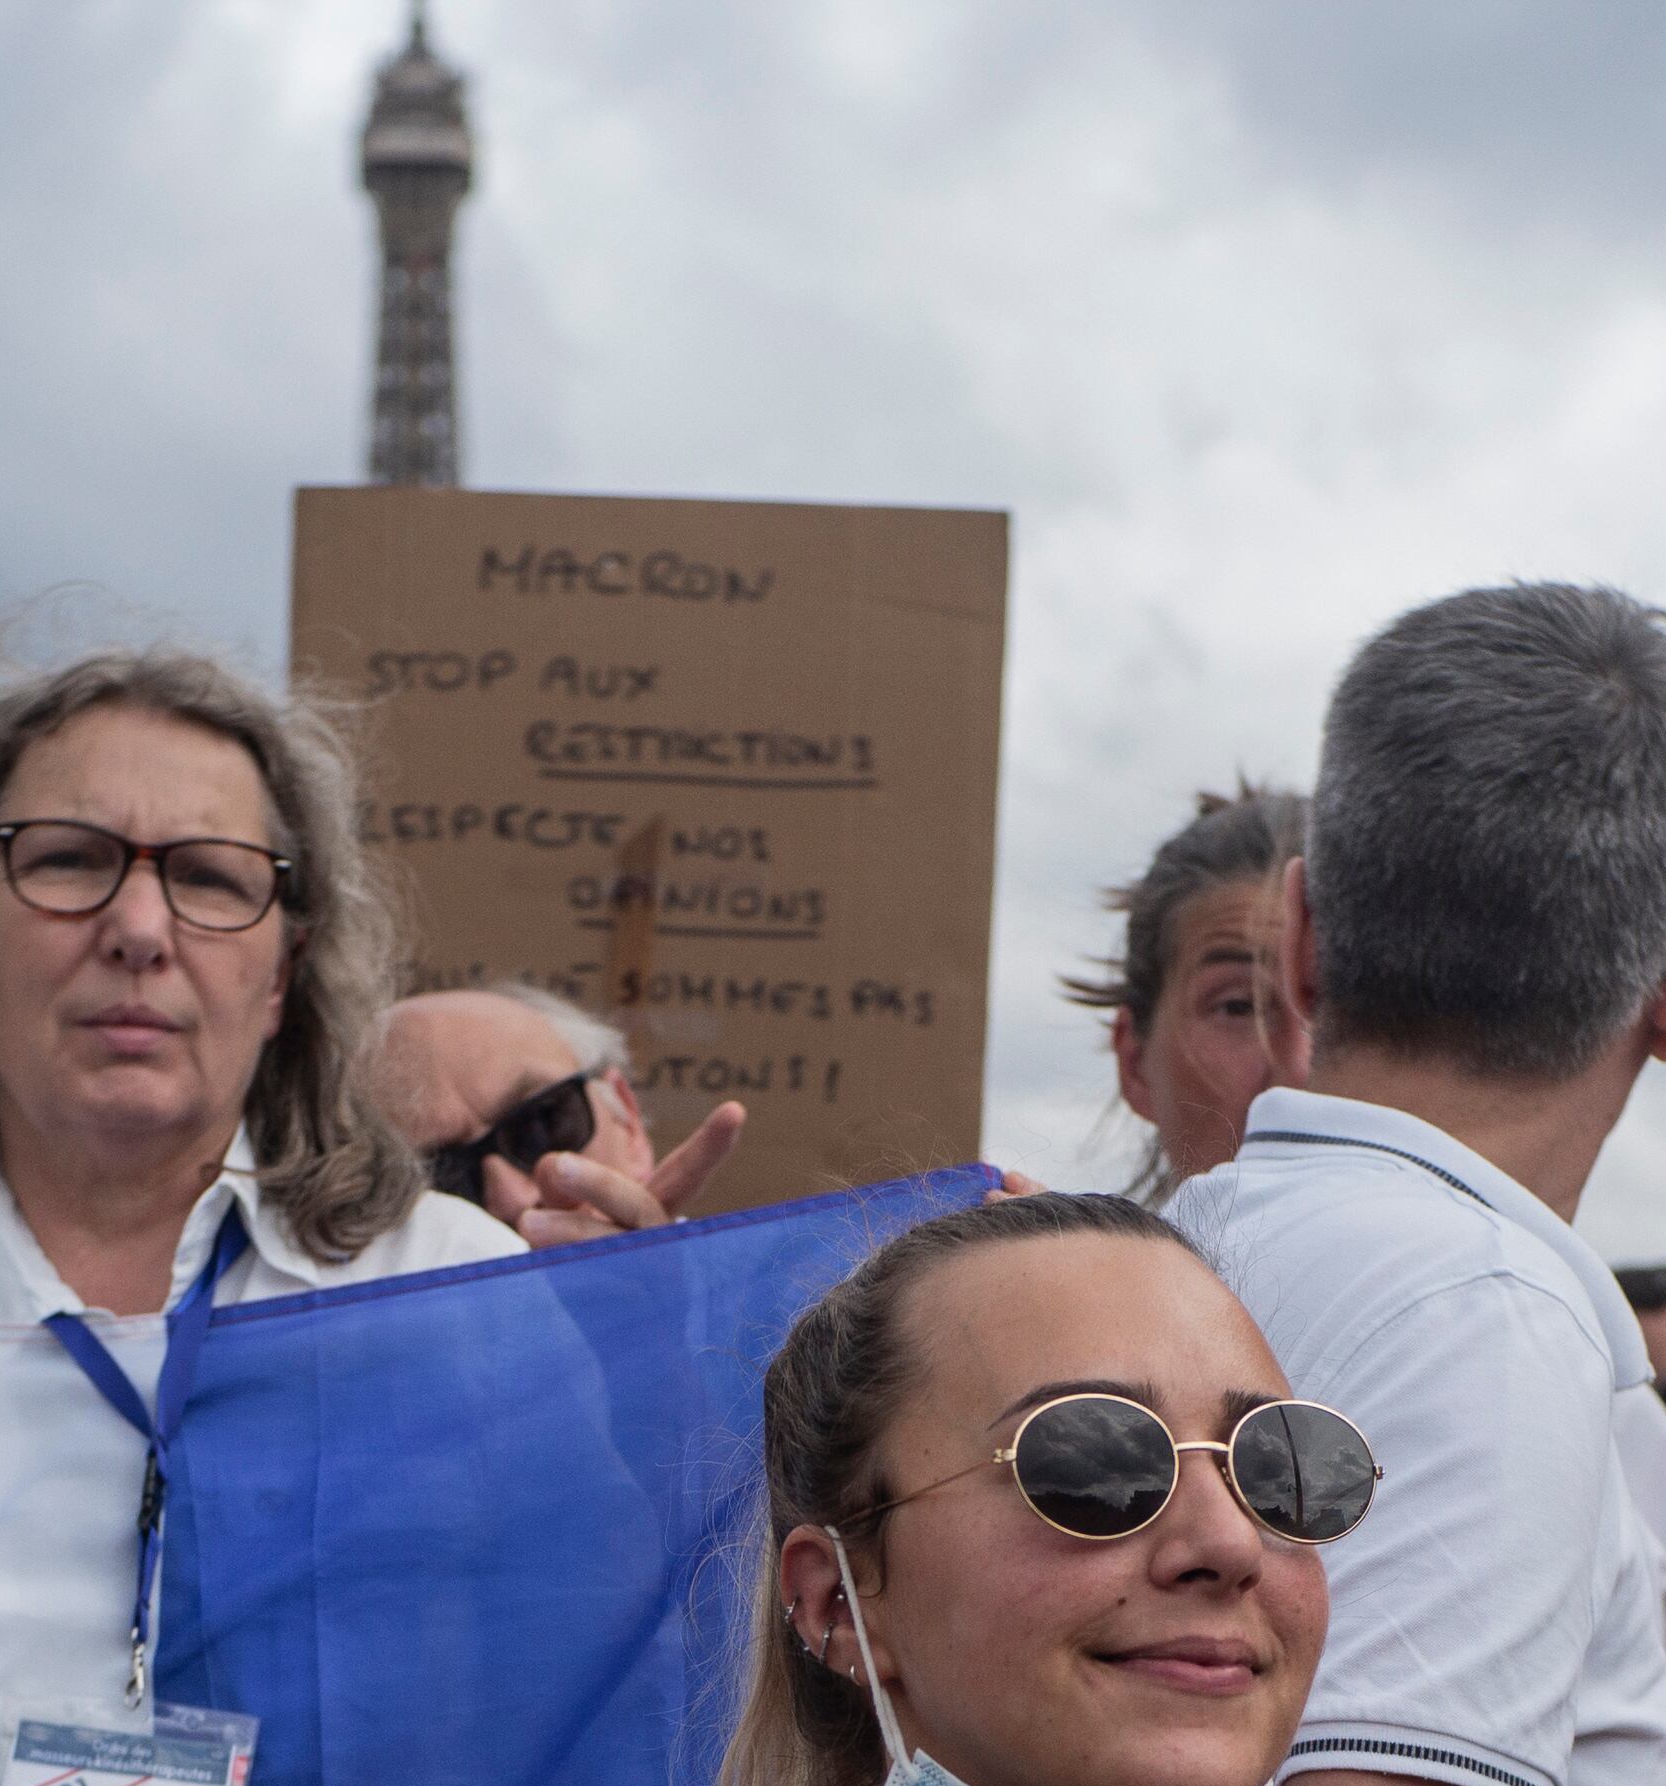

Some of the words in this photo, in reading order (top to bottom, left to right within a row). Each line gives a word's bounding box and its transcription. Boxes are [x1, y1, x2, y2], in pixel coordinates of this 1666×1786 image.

[477, 543, 777, 604] MACRON
[366, 649, 517, 698] STOP
[540, 655, 661, 700] AUX
[669, 824, 771, 864] NOS
[849, 978, 935, 1027] PAS
